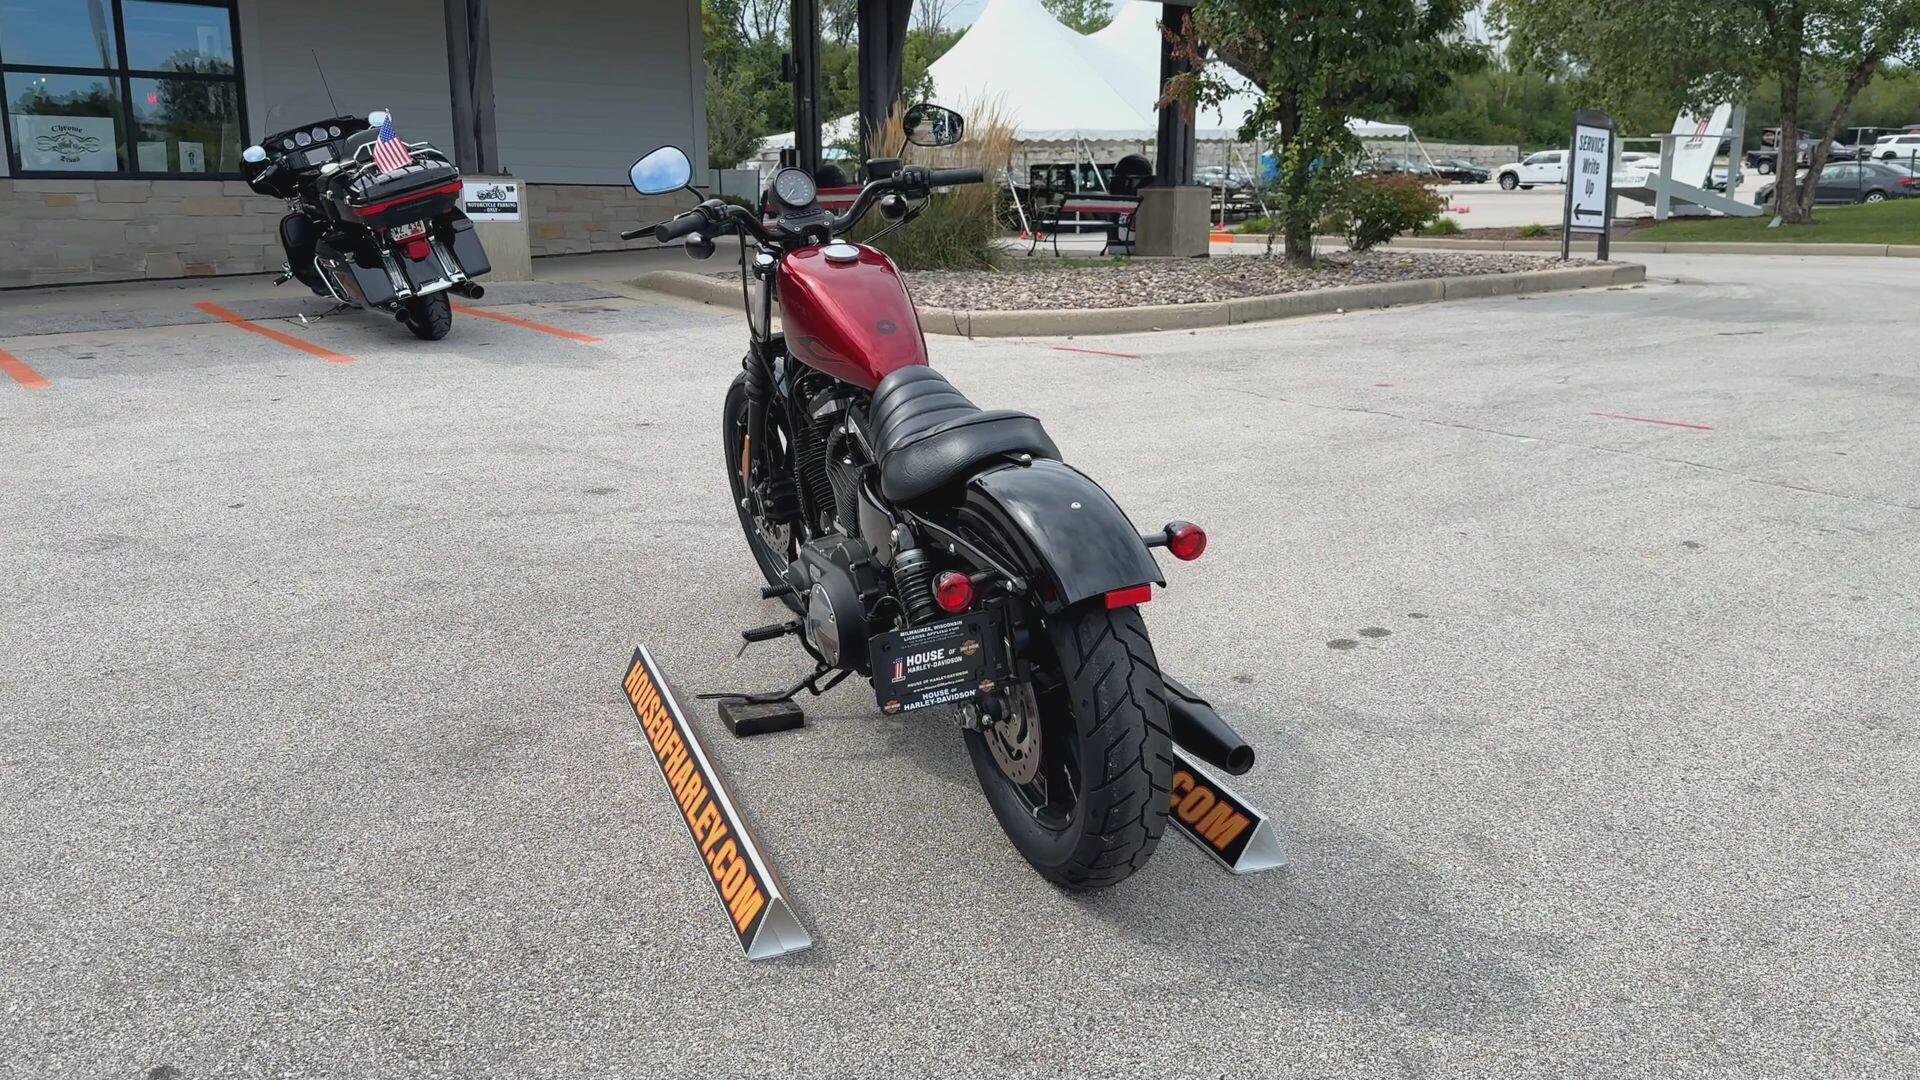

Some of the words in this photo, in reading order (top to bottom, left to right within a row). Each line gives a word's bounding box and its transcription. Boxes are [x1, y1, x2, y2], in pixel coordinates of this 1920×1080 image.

[1579, 134, 1605, 153] SERVICE
[1582, 157, 1600, 175] Write
[1585, 178, 1595, 198] Up
[933, 620, 963, 631] WISCONSIN
[903, 633, 926, 642] LICENSE
[906, 648, 945, 667] HOUSE
[907, 655, 963, 674] HARLEY-DAVIDSON
[907, 680, 922, 688] HOUSE
[903, 690, 975, 711] HARLEY-DAVIDSON
[922, 688, 950, 700] HOUSE
[624, 659, 766, 934] HOUSEOFHARLEY.COM
